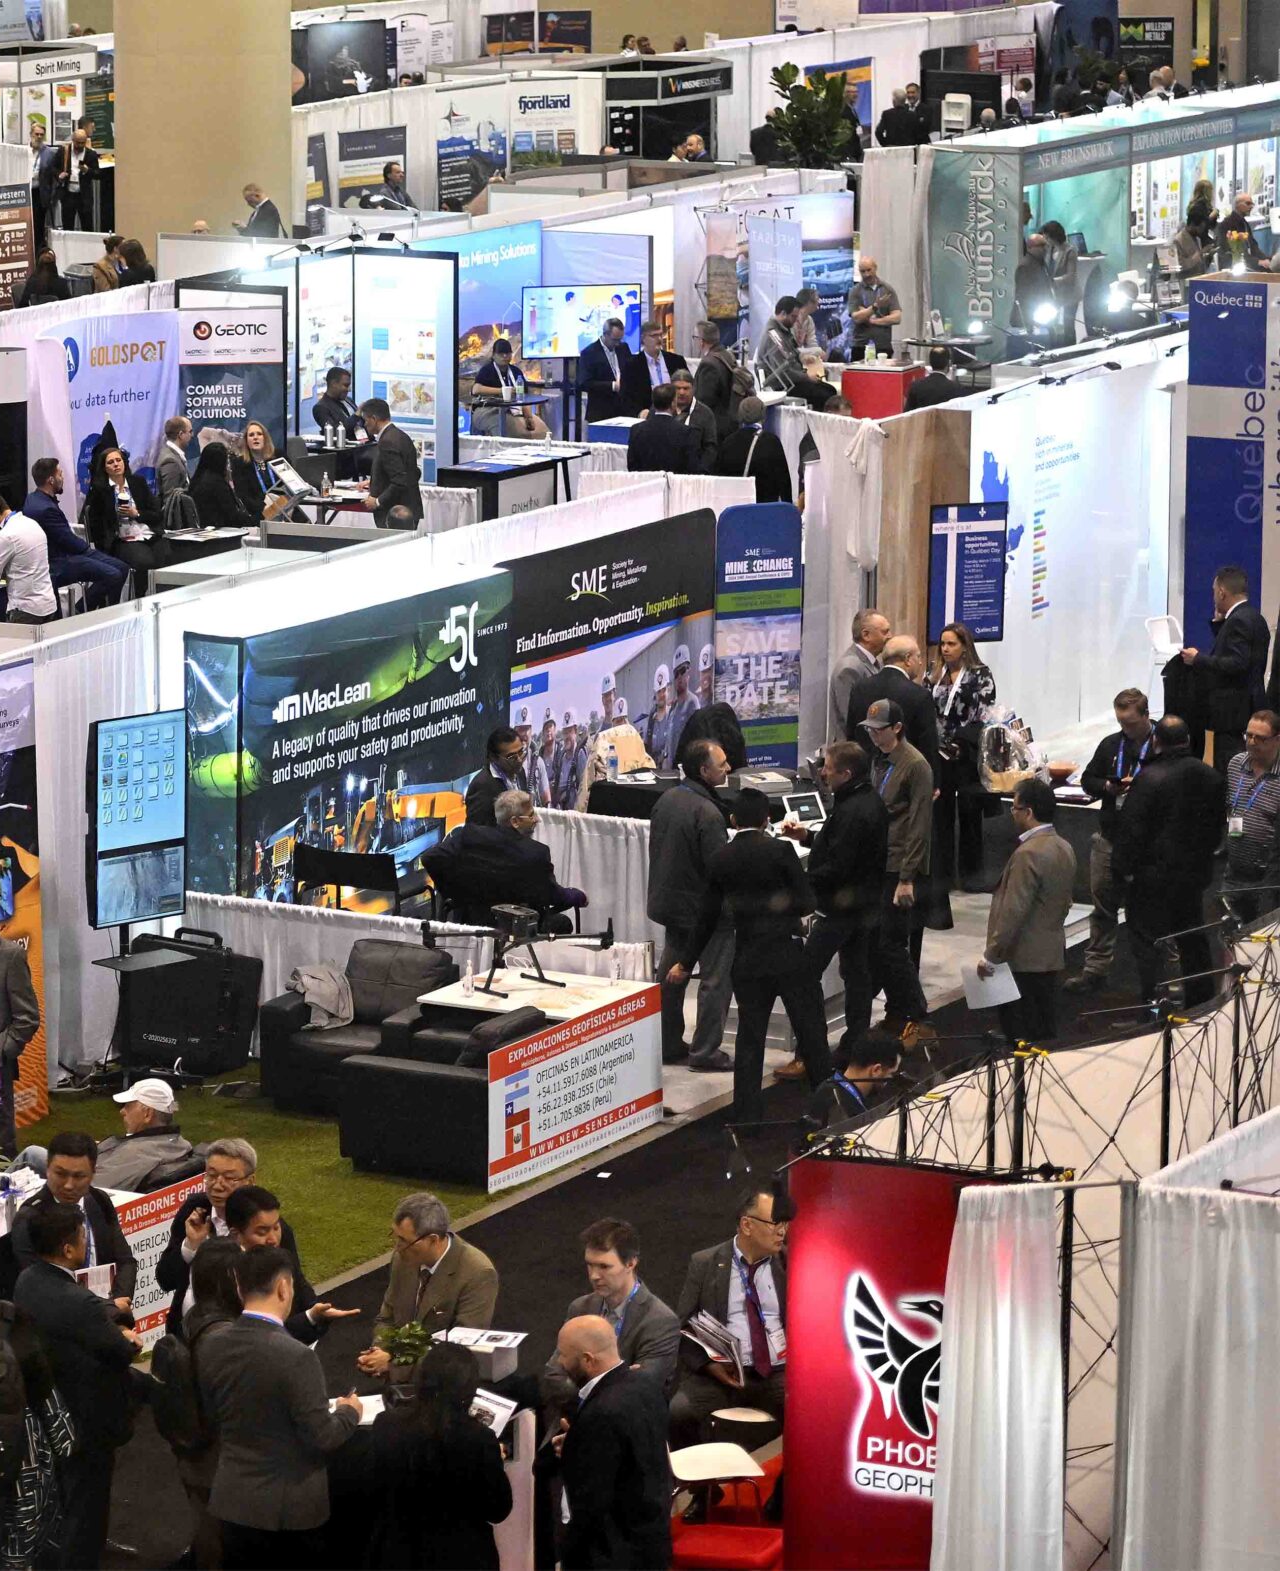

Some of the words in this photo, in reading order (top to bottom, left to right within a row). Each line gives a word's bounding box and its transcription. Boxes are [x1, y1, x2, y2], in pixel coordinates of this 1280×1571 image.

[1145, 31, 1166, 41] METALS
[35, 62, 54, 75] Spirit
[56, 60, 80, 72] Mining
[519, 94, 571, 114] fjordland
[1132, 128, 1181, 151] EXPLORATION
[1182, 118, 1233, 142] OPPORTUNITIES
[1037, 153, 1059, 170] NEW
[1061, 141, 1113, 165] BRUNSWICK
[965, 178, 977, 233] Nouveau
[968, 156, 994, 318] Brunswick
[471, 248, 499, 267] Mining
[500, 243, 536, 260] Solutions
[965, 266, 978, 296] New
[1194, 291, 1243, 307] Québec
[215, 324, 268, 336] GEOTIC
[90, 340, 166, 367] GOLDSPOT
[85, 394, 106, 407] data
[109, 389, 150, 404] further
[186, 385, 243, 394] COMPLETE
[186, 397, 243, 406] SOFTWARE
[186, 408, 246, 419] SOLUTIONS
[1234, 364, 1265, 524] Québec
[571, 566, 608, 600] SME
[477, 627, 493, 637] SINCE
[495, 622, 508, 632] 1973
[516, 632, 536, 653] Find
[538, 620, 590, 648] Information.
[592, 608, 644, 632] Opportunity.
[646, 594, 689, 616] Inspiration.
[725, 630, 791, 653] SAVE
[735, 656, 781, 680] THE
[303, 682, 370, 717] MacLean
[725, 681, 789, 706] DATE
[272, 741, 279, 759] A
[283, 733, 313, 755] legacy
[316, 729, 326, 746] of
[328, 722, 360, 743] quality
[362, 715, 381, 731] that
[383, 710, 410, 728] drives
[412, 706, 428, 719] our
[430, 688, 475, 714] innovation
[272, 767, 291, 784] and
[294, 757, 335, 780] supports
[337, 753, 357, 768] your
[360, 743, 389, 761] safety
[391, 735, 408, 749] and
[410, 717, 464, 742] productivity.
[508, 1028, 570, 1064] EXPLORACIONES
[572, 1010, 616, 1034] GEOFÍSICAS
[618, 997, 646, 1016] AÉREAS
[536, 1060, 568, 1083] OFICINAS
[571, 1057, 579, 1069] EN
[581, 1034, 634, 1065] LATINOAMERICA
[537, 1064, 597, 1098] +54.11.5917.6088
[599, 1050, 635, 1075] (Argentina)
[537, 1085, 594, 1115] +56.22.938.2555
[596, 1074, 616, 1092] (Chile)
[537, 1101, 590, 1132] +51.1.705.9836
[592, 1092, 612, 1111] (Perú)
[529, 1104, 637, 1158] WWW.NEW-SENSE.COM
[125, 1195, 175, 1223] AIRBORNE
[866, 1437, 936, 1468] PHOE
[855, 1467, 933, 1497] GEOPH
